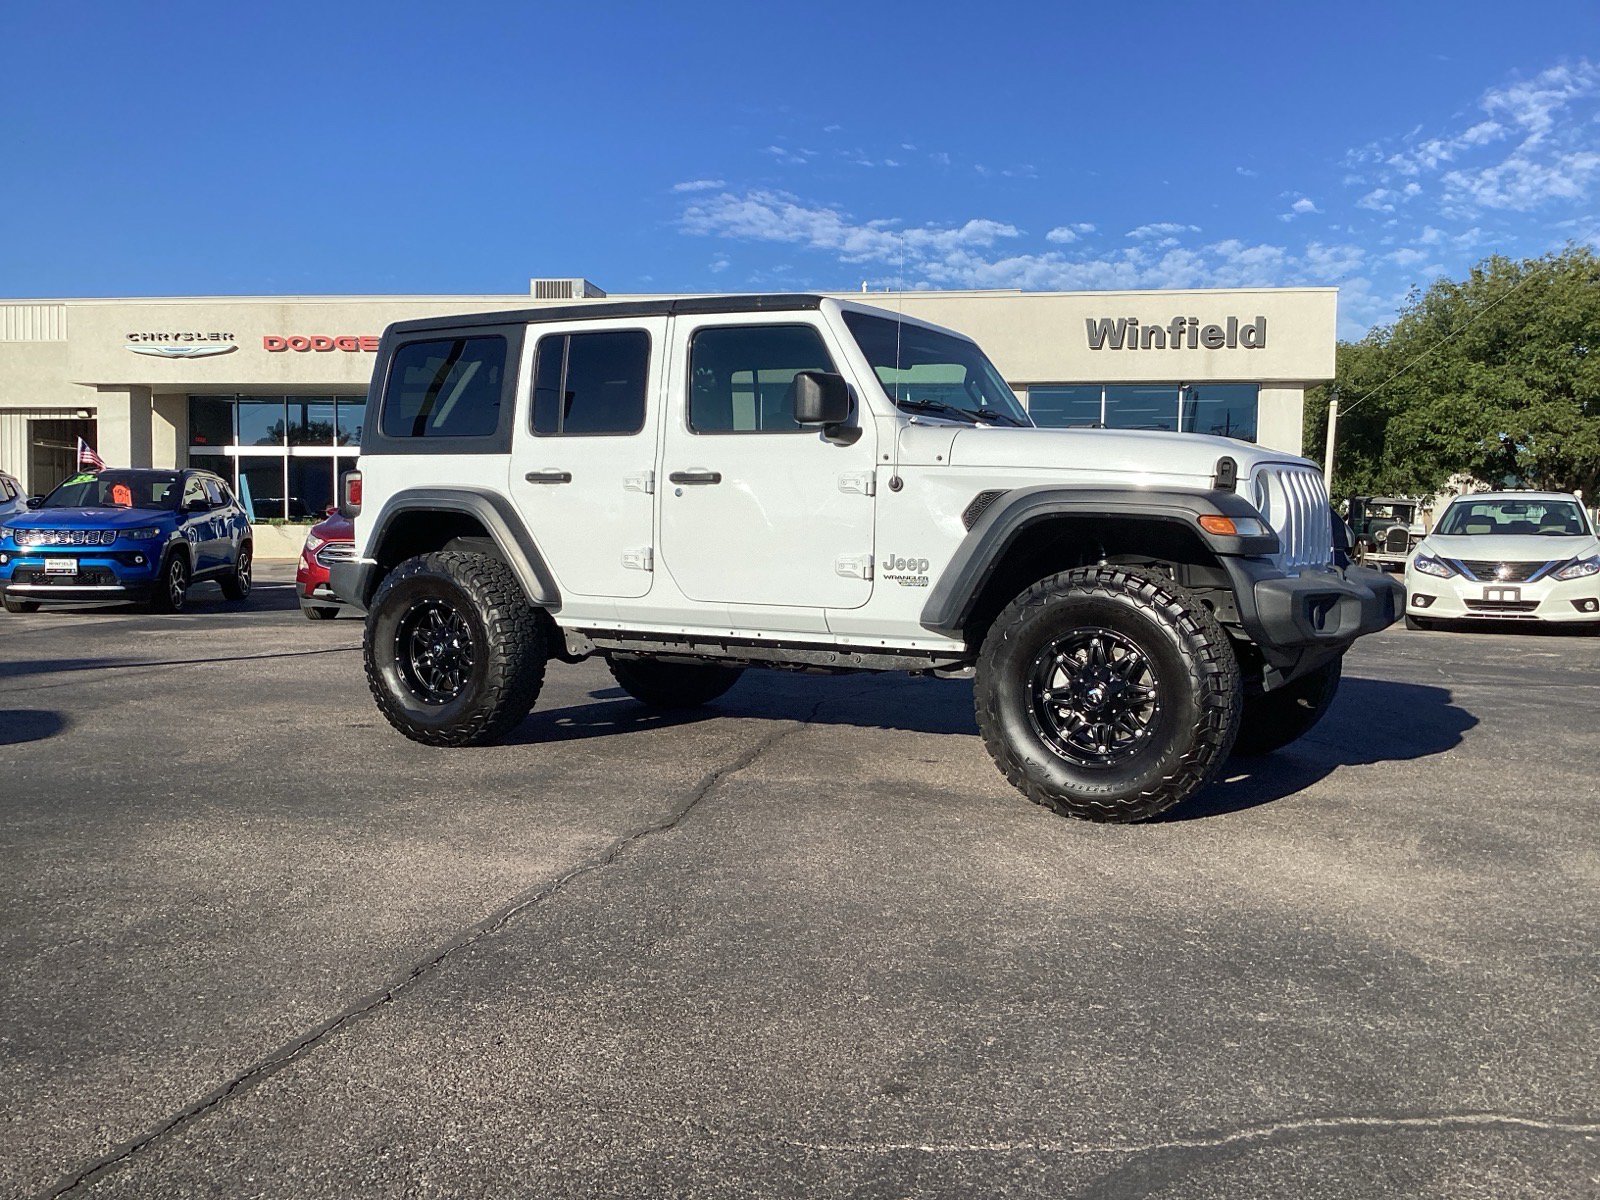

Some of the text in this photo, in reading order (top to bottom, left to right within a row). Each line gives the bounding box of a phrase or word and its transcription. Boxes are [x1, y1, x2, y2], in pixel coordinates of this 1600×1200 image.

[126, 332, 236, 342] CHRYSLER
[1085, 316, 1268, 350] Winfield
[263, 335, 380, 353] DODGE
[882, 554, 929, 574] Jeep
